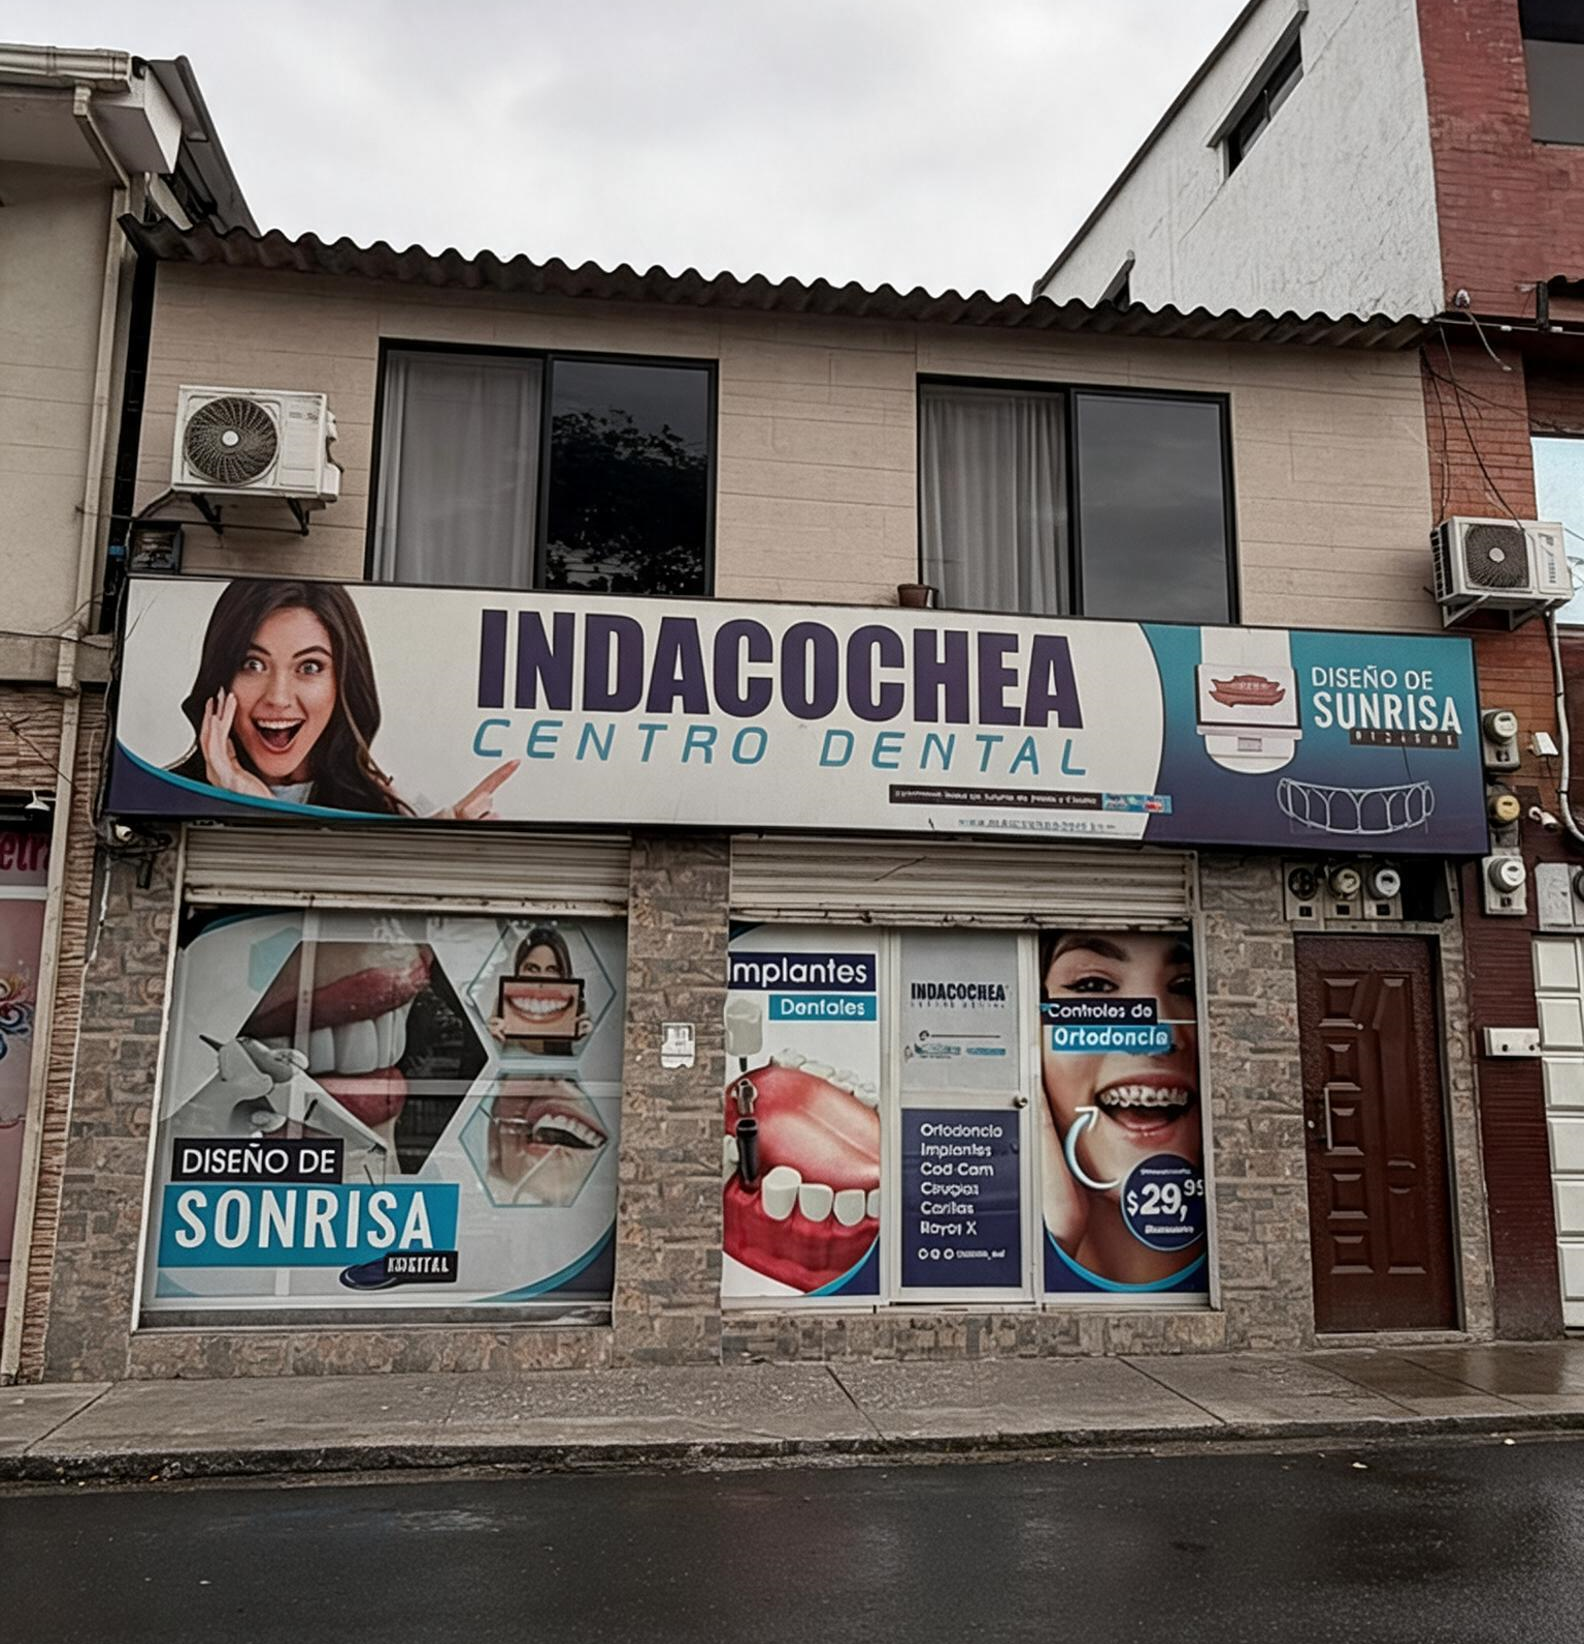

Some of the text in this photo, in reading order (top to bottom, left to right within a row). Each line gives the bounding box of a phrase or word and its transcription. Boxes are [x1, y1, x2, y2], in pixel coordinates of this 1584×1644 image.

[477, 609, 1083, 729] INDACOCHEA
[1312, 665, 1433, 691] DISEÑO DE
[1313, 691, 1462, 734] SUNRISA
[472, 718, 1088, 776] CENTRO DENTAL
[727, 956, 868, 988] Implantes
[911, 982, 1006, 1001] INDACOCHEA
[182, 1142, 336, 1174] DISEÑO DE
[175, 1189, 434, 1249] SONRISA
[966, 1221, 977, 1235] X
